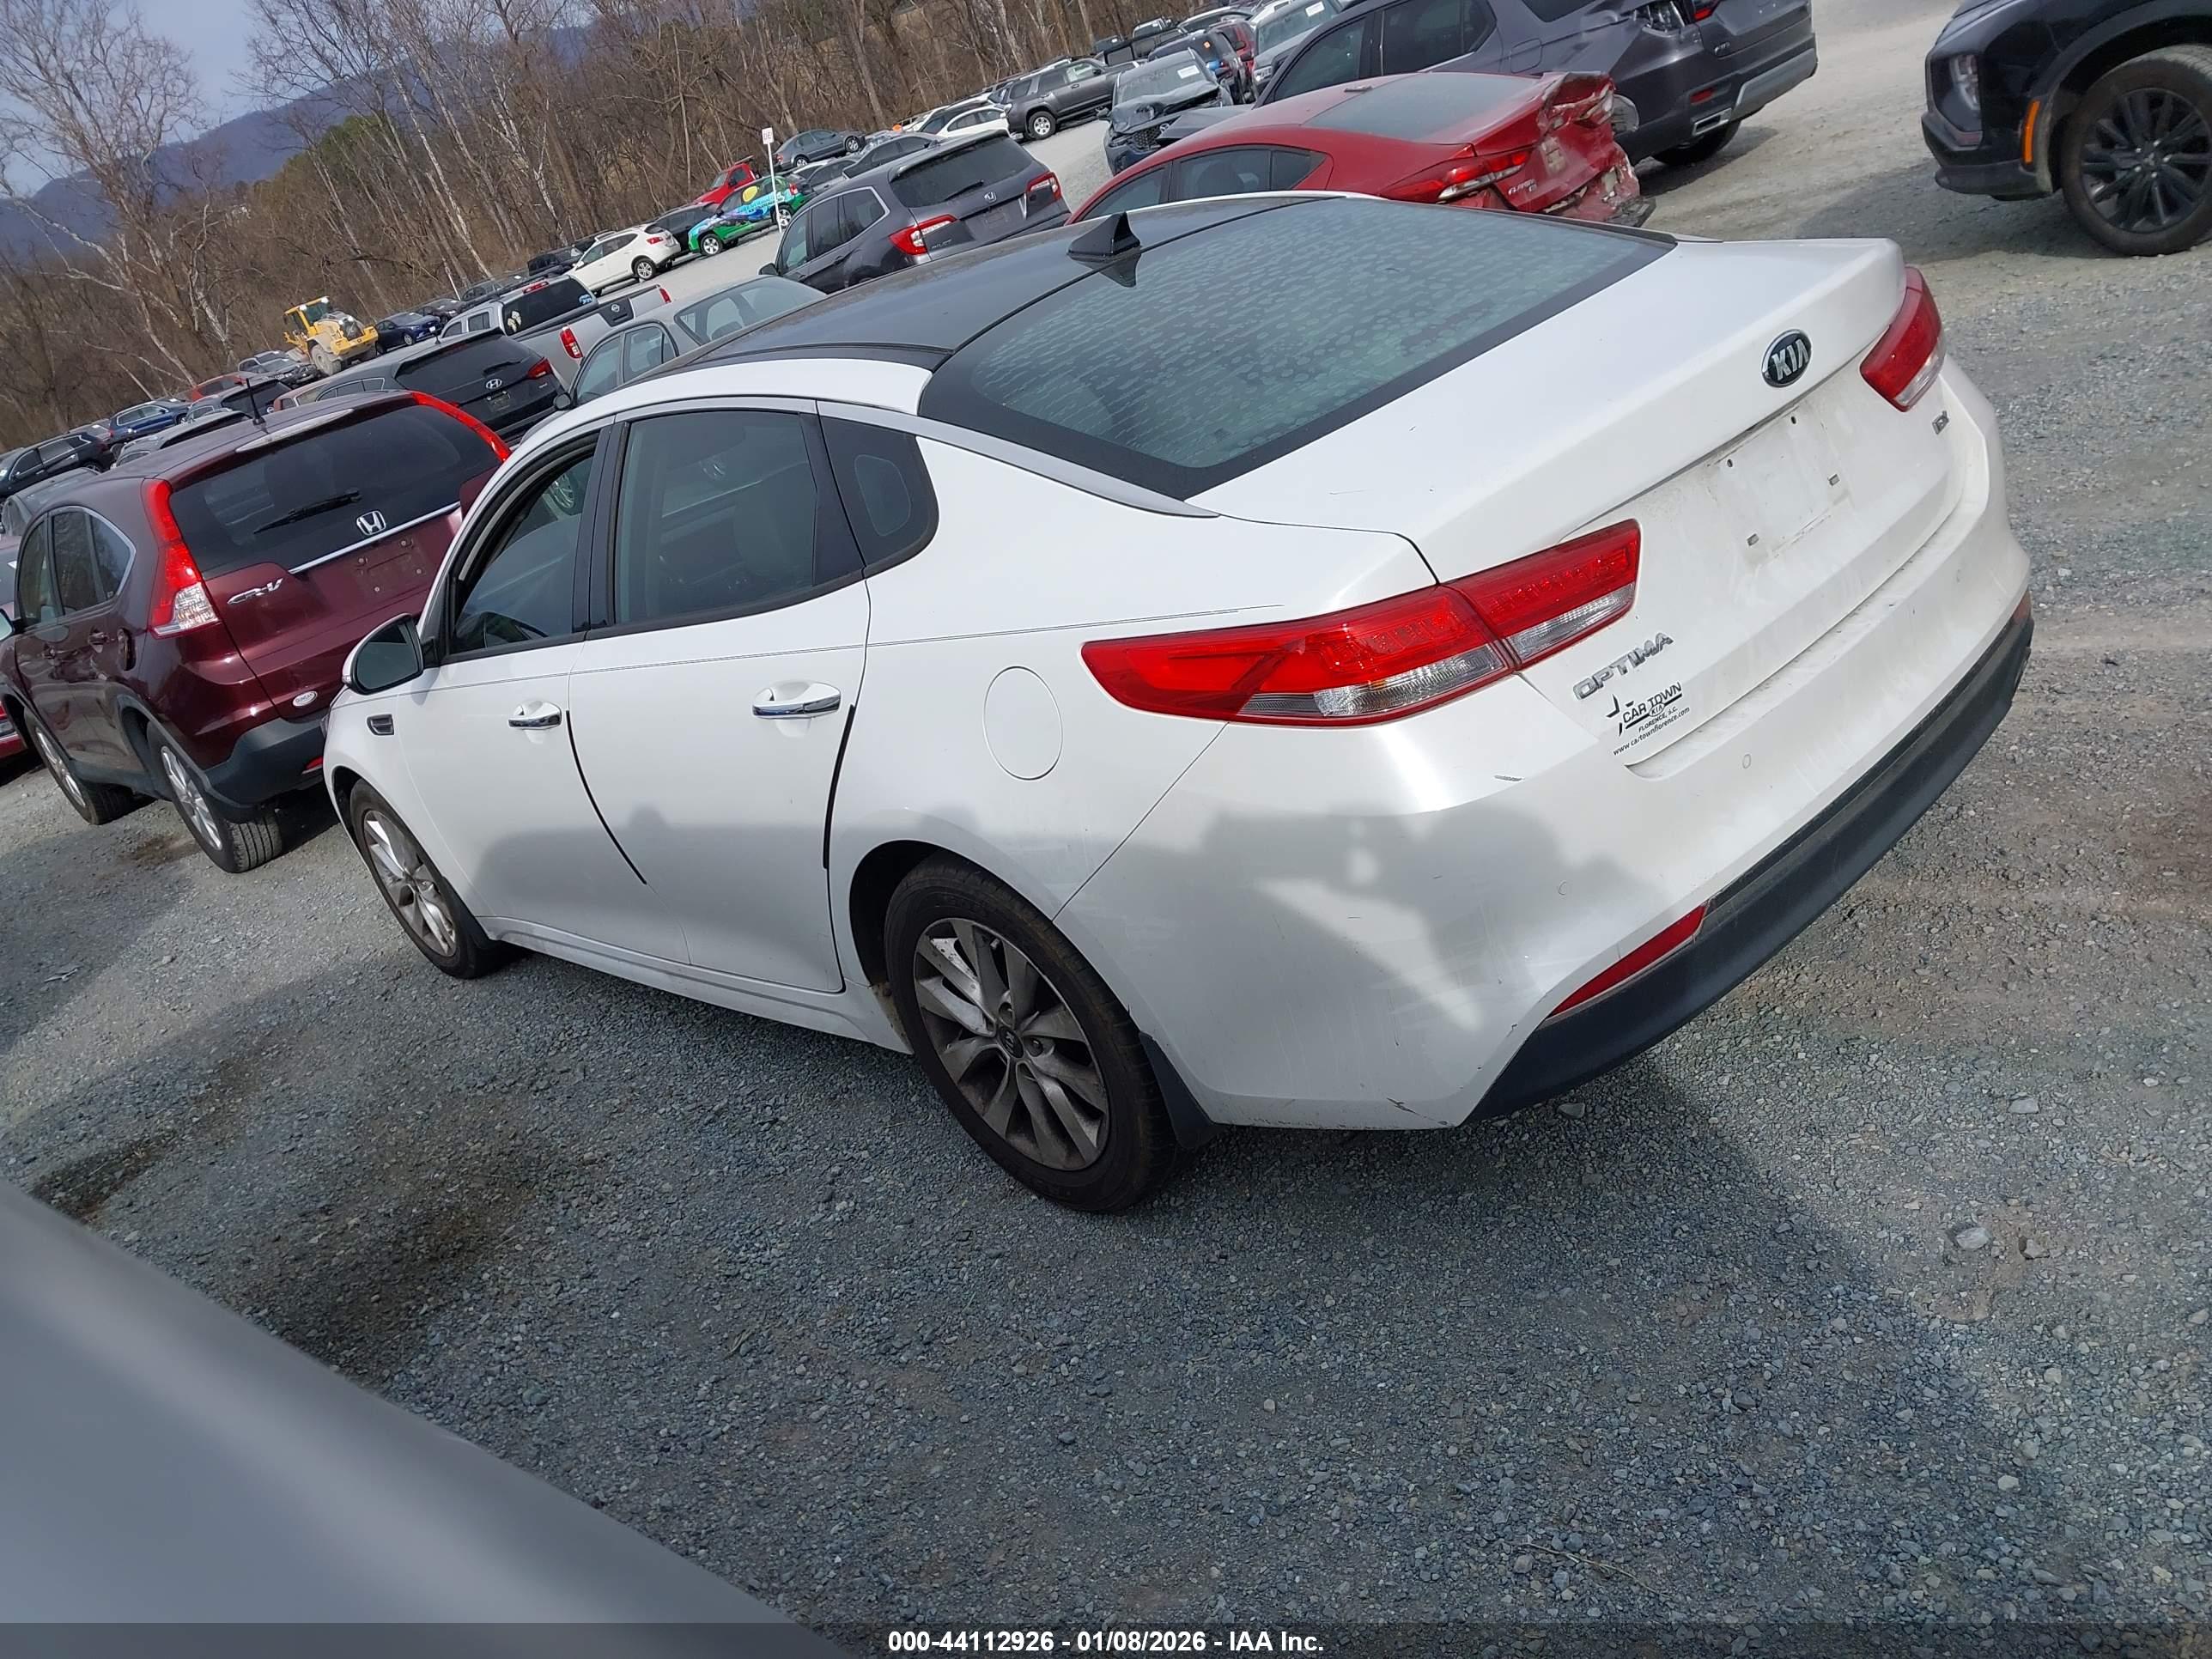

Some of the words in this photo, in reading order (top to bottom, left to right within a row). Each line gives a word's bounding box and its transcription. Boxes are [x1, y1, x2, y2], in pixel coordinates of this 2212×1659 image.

[1771, 339, 1809, 380] KIA
[227, 578, 283, 605] CR-V
[1573, 632, 1674, 700] OPTIMA
[1623, 702, 1647, 723] CAR
[1647, 681, 1681, 708] TOWN
[1651, 704, 1664, 714] KIA
[1613, 707, 1690, 755] wwwcartownflorence.com
[1638, 714, 1668, 732] FLORENCE,
